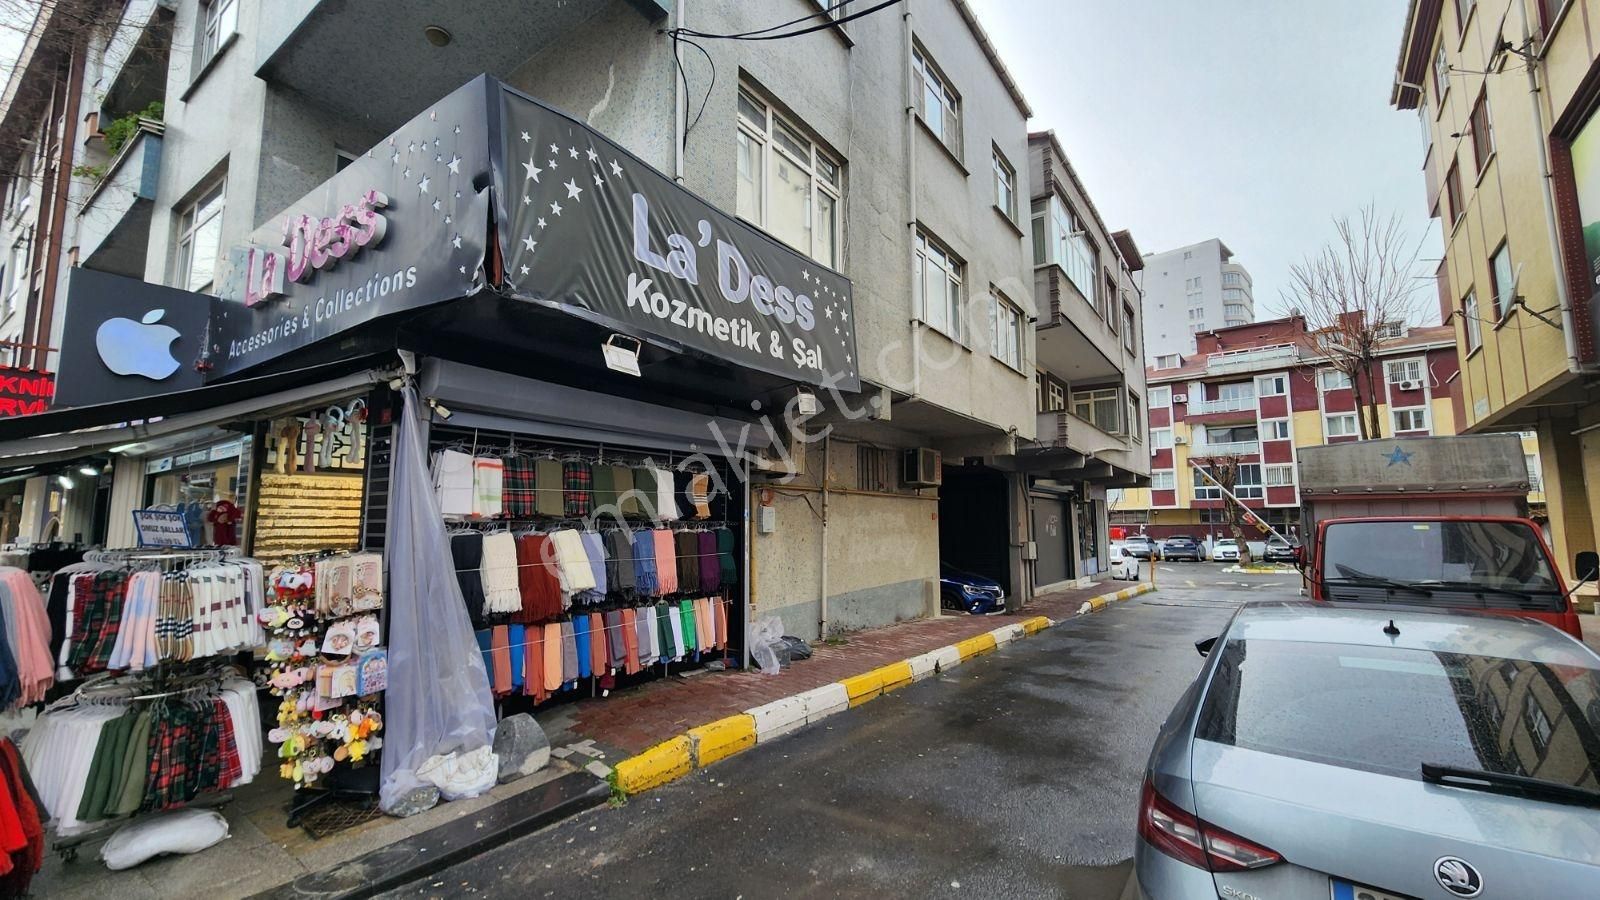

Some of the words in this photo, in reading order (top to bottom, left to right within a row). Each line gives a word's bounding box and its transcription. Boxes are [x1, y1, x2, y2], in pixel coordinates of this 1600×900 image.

[245, 190, 389, 307] La'Dess
[632, 193, 816, 331] La'Dess
[228, 317, 298, 360] Accessories
[302, 306, 310, 329] &
[315, 266, 417, 323] Collections
[627, 273, 762, 353] Kozmetik
[770, 331, 785, 360] &
[792, 337, 823, 371] Şal
[0, 397, 48, 416] RVİ
[1223, 885, 1262, 900] SKO
